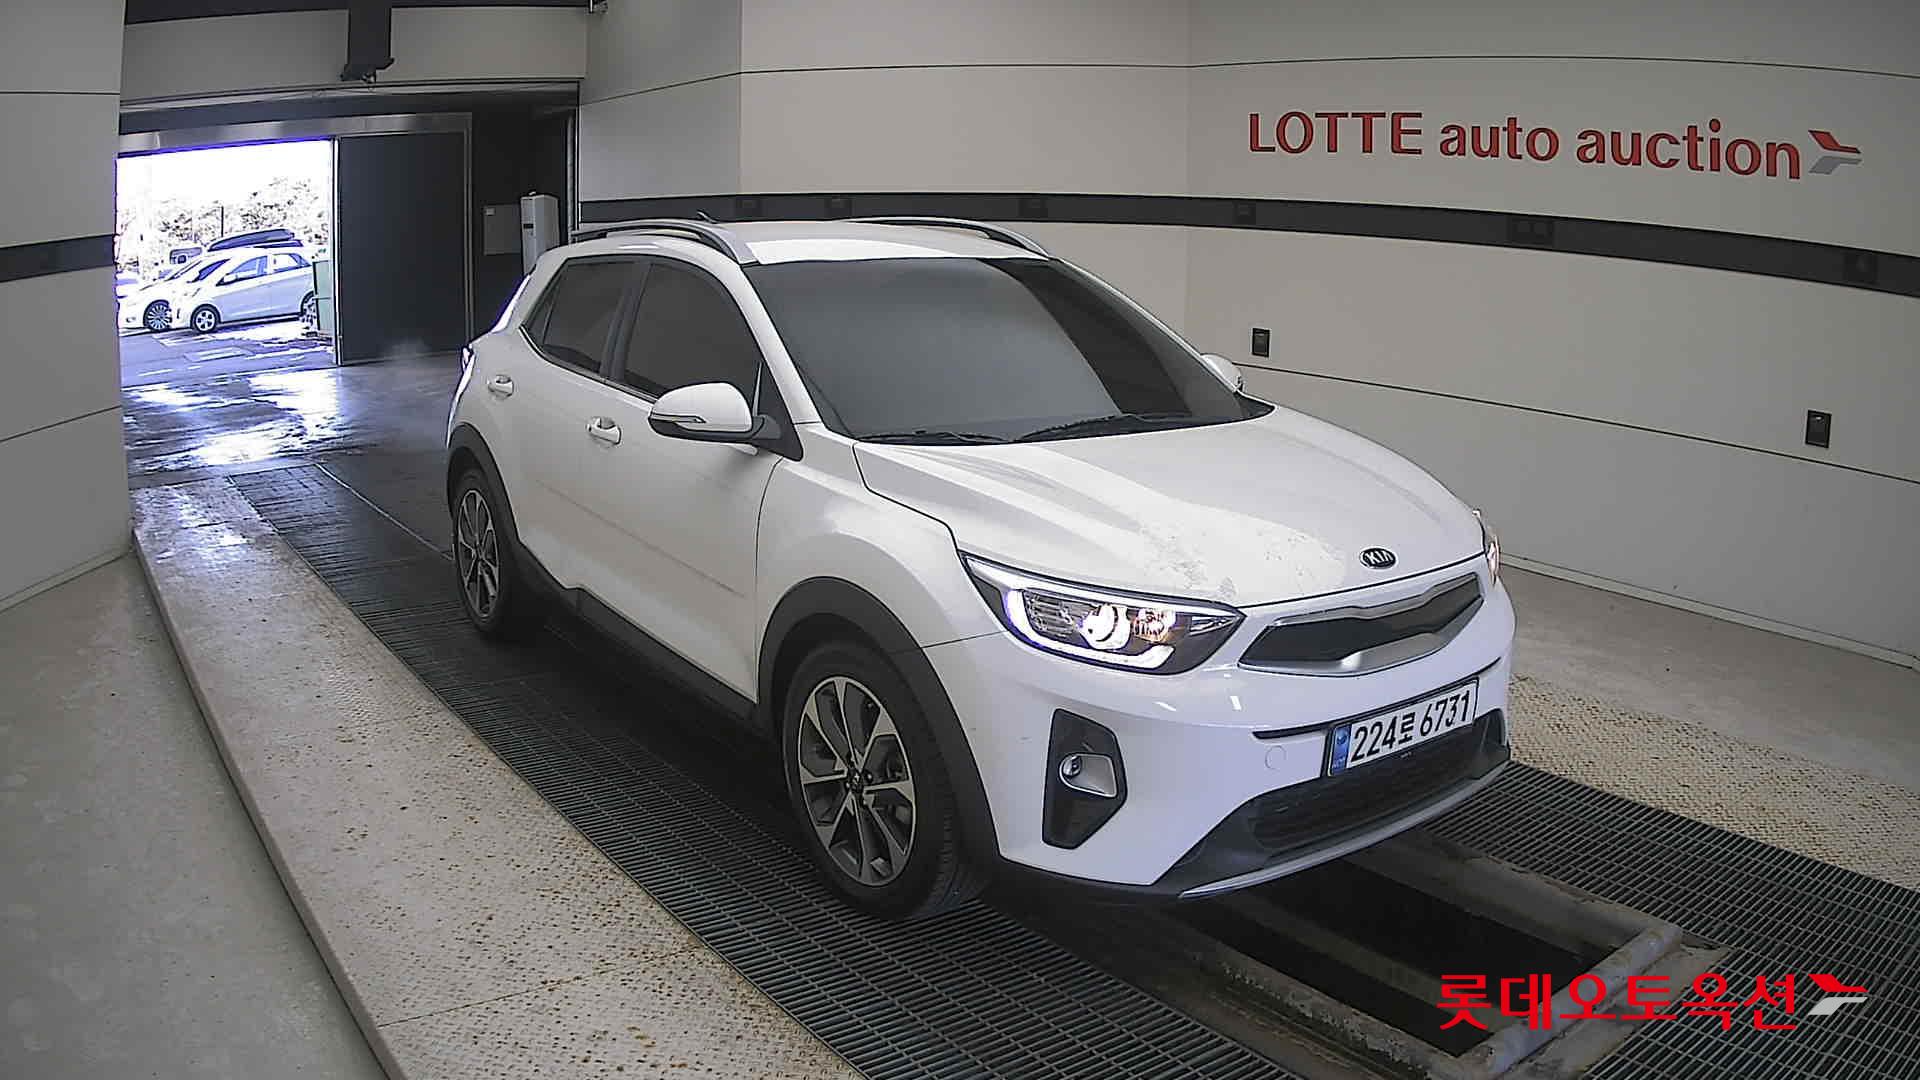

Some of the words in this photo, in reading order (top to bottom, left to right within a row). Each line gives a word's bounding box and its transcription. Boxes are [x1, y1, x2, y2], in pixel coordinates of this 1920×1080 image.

[1249, 111, 1424, 155] LOTTE
[1439, 116, 1560, 162] auto
[1575, 118, 1801, 180] auction
[1419, 689, 1471, 737] 6731
